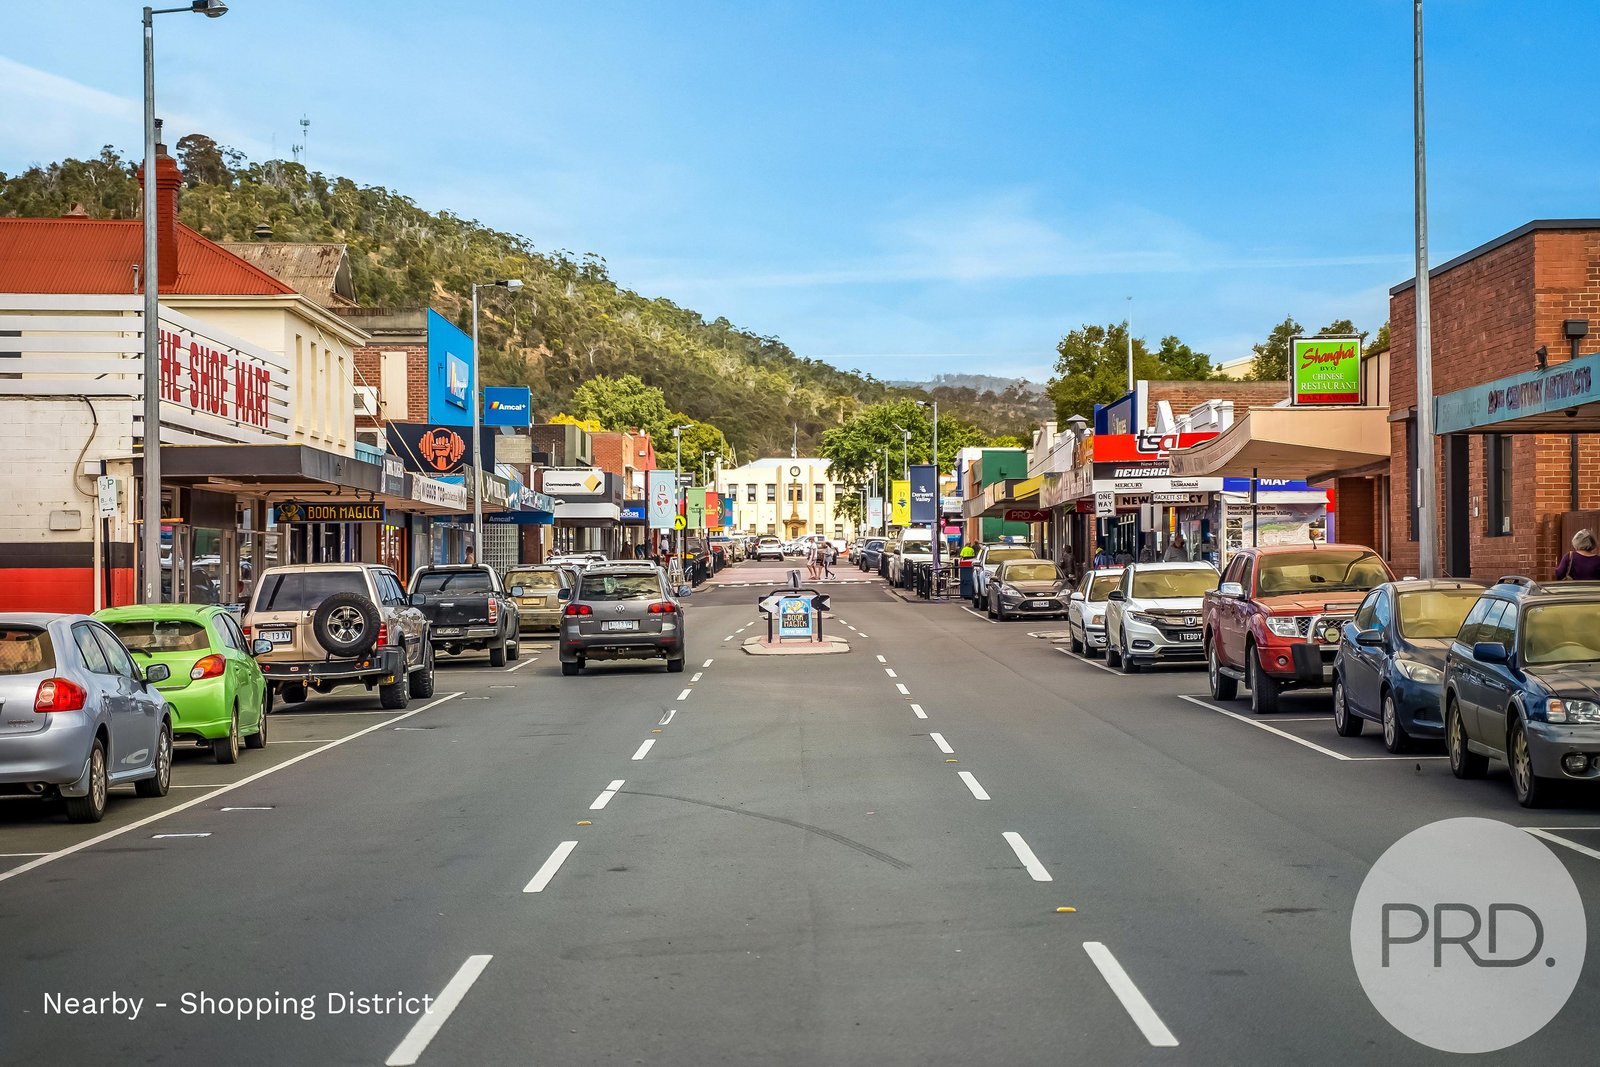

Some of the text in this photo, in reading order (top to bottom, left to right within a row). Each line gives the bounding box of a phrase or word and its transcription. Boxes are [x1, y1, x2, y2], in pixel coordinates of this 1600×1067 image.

[1301, 343, 1355, 369] Shanghai
[158, 328, 270, 428] HE SHOE MART
[1301, 382, 1357, 390] RESTAURANT
[1505, 378, 1543, 410] CENTURY
[308, 506, 380, 519] BOOK MAGICK
[1011, 511, 1030, 519] PRD
